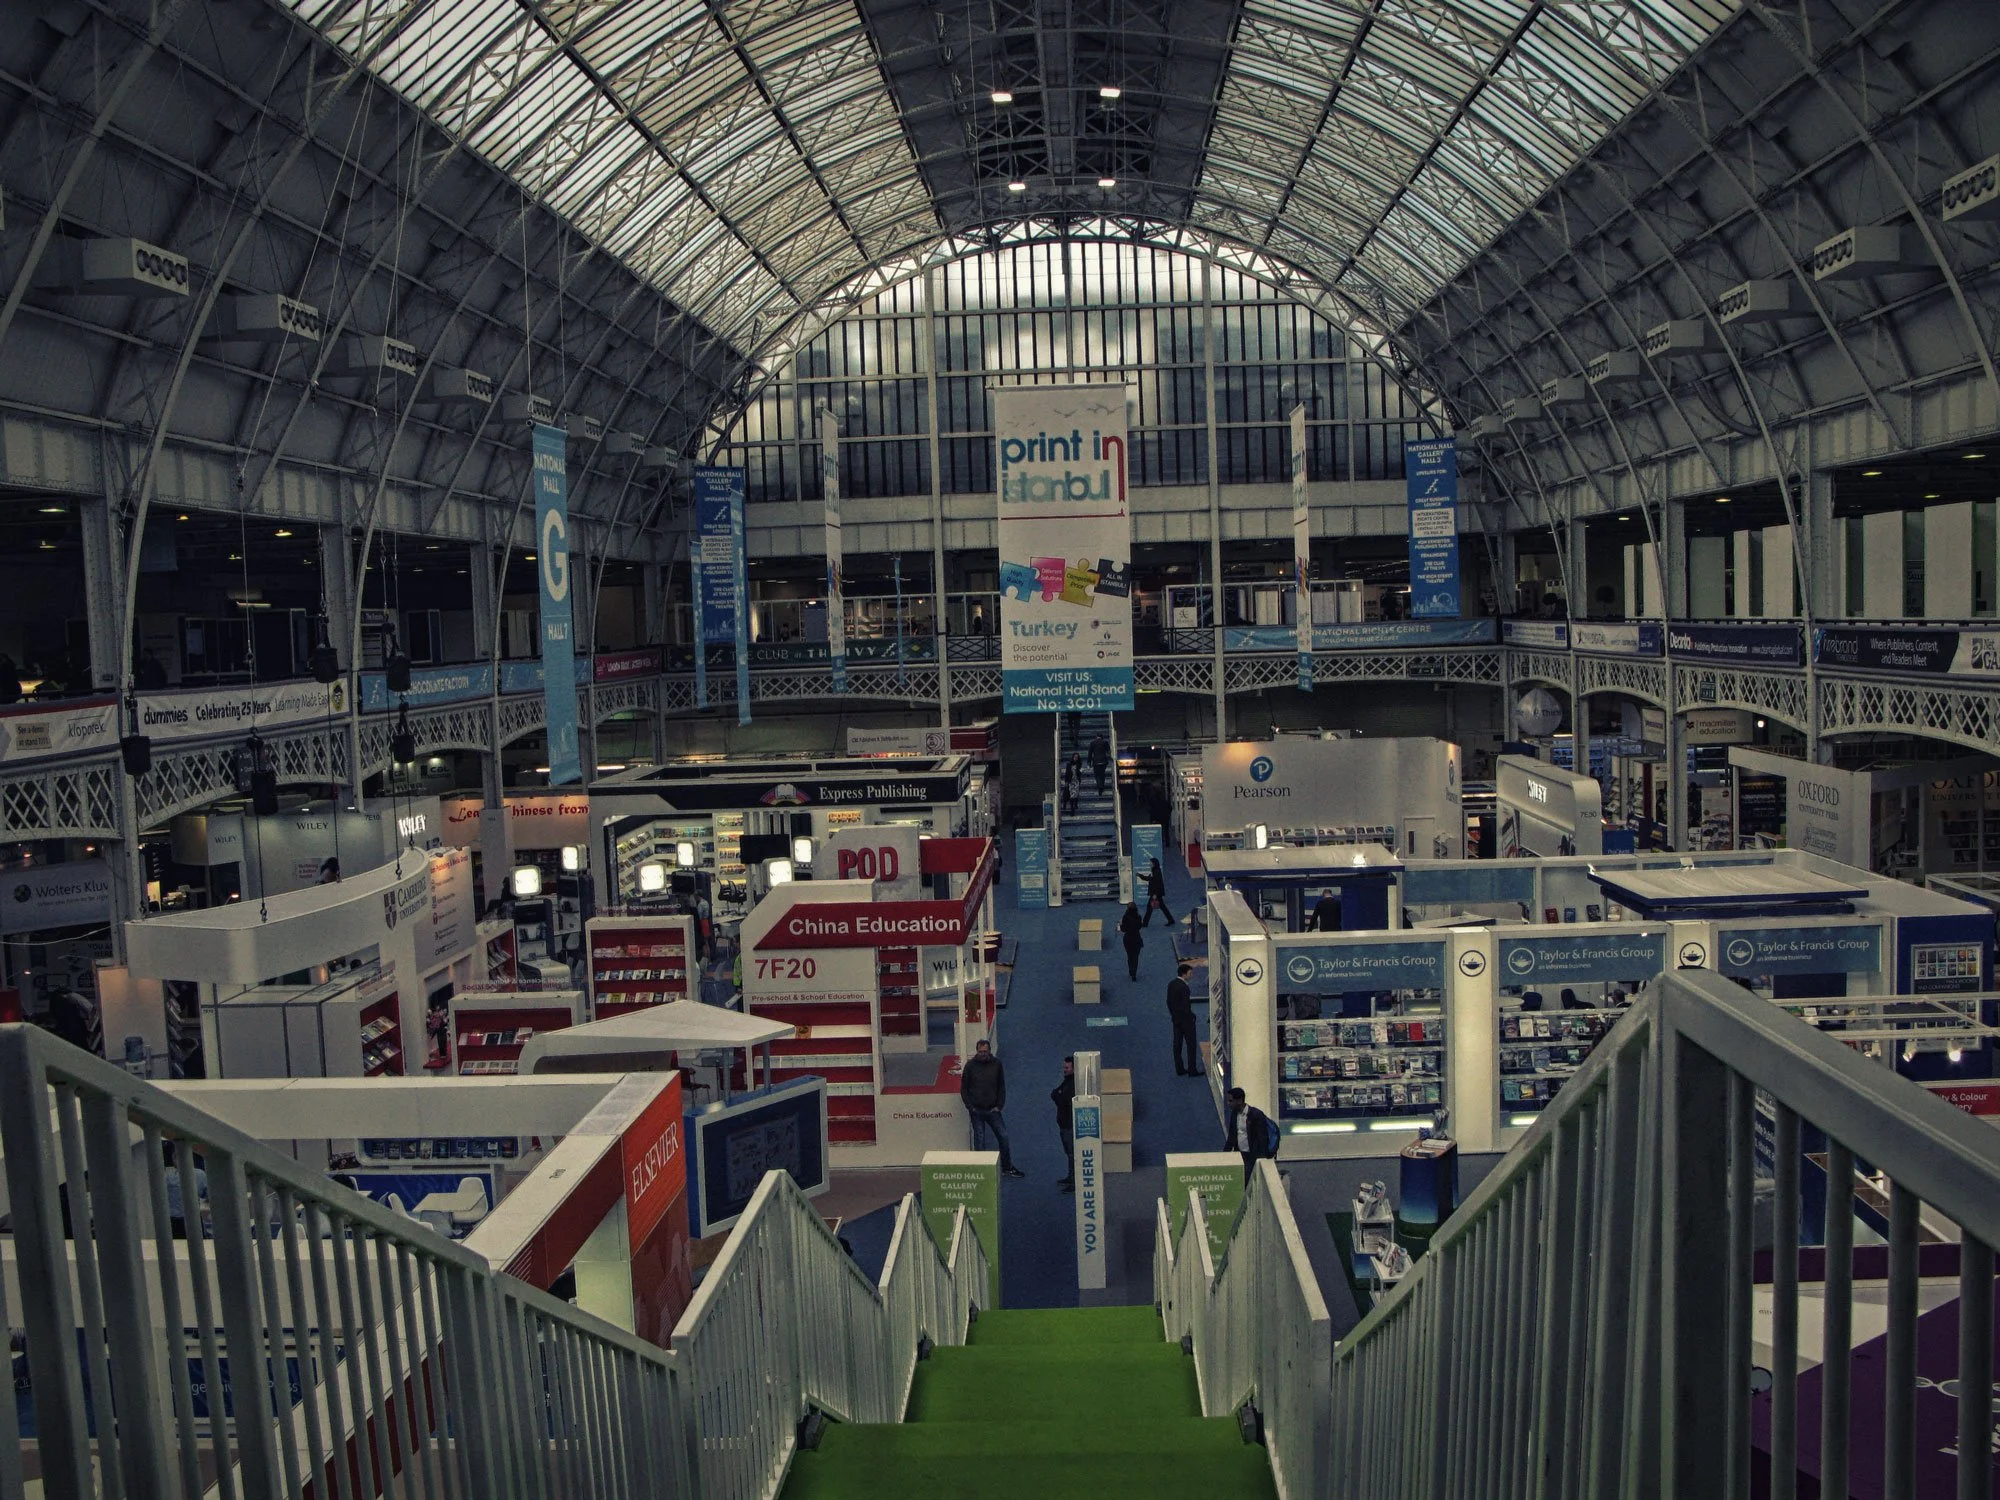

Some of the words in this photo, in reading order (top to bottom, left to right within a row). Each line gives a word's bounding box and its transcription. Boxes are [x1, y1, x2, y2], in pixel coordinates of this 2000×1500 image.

[1001, 429, 1083, 470] print
[1408, 444, 1438, 452] NATIONAL
[1417, 450, 1444, 458] GALLERY
[533, 453, 566, 475] NATIONAL
[543, 475, 559, 494] HALL
[1002, 470, 1110, 503] istanbul
[542, 508, 568, 602] G
[1010, 569, 1023, 577] High
[1106, 572, 1115, 580] ALL
[548, 623, 563, 640] HALL
[1009, 620, 1078, 640] Turkey
[1396, 625, 1432, 634] CENTRE
[1013, 643, 1050, 652] Discover
[1870, 637, 1887, 650] Where
[1915, 640, 1939, 653] Content,
[1984, 638, 1995, 650] Net
[757, 649, 789, 660] CLUB
[845, 646, 876, 657] IVY
[1013, 654, 1028, 662] the
[1029, 653, 1068, 662] potential
[1881, 654, 1891, 664] and
[1891, 654, 1912, 666] Readers
[1912, 655, 1927, 666] Meet
[1046, 672, 1072, 682] VISIT
[1075, 671, 1093, 682] US:
[1010, 685, 1062, 697] National
[1065, 685, 1088, 696] Hall
[1090, 684, 1126, 695] Stand
[275, 697, 300, 712] Learning
[301, 694, 317, 708] Made
[1037, 699, 1061, 709] No:
[1067, 698, 1101, 709] 3C01
[144, 705, 189, 725] dummies
[196, 702, 240, 721] Celebrating
[241, 702, 252, 715] 25
[252, 701, 272, 714] Years
[1699, 727, 1736, 735] education
[819, 786, 864, 803] Express
[866, 784, 927, 800] Publishing
[1234, 786, 1291, 798] Pearson
[1798, 779, 1840, 806] OXFORD
[448, 807, 480, 823] Lea
[558, 803, 590, 816] from
[1798, 804, 1824, 818] UNIVERSITY
[1825, 810, 1839, 821] PRESS
[296, 821, 329, 830] WILEY
[398, 814, 427, 837] WILEY
[214, 836, 236, 844] WILEY
[838, 846, 899, 881] POD
[36, 885, 82, 897] Wolters
[788, 918, 850, 935] China
[856, 915, 961, 933] Education
[1756, 942, 1787, 955] Taylor
[1790, 941, 1799, 950] &
[1801, 940, 1834, 950] Francis
[1838, 939, 1869, 951] Group
[1318, 958, 1349, 971] Taylor
[1352, 958, 1361, 968] &
[1363, 957, 1399, 967] Francis
[1402, 955, 1436, 970] Group
[1538, 950, 1569, 963] Taylor
[1572, 949, 1580, 959] &
[1582, 948, 1619, 959] Francis
[1621, 948, 1655, 960] Group
[754, 957, 816, 979] 7F20
[933, 957, 968, 972] WILY
[827, 992, 864, 1000] Education
[1951, 1093, 1958, 1101] &
[1960, 1092, 1989, 1101] Colour
[632, 1121, 678, 1204] ELSEVIER
[1082, 1149, 1094, 1188] HERE
[932, 1172, 963, 1180] GRAND
[964, 1172, 985, 1180] HALL
[1180, 1175, 1210, 1183] GRAND
[940, 1182, 978, 1190] GALLERY
[1083, 1191, 1096, 1220] ARE
[1084, 1223, 1096, 1254] YOU
